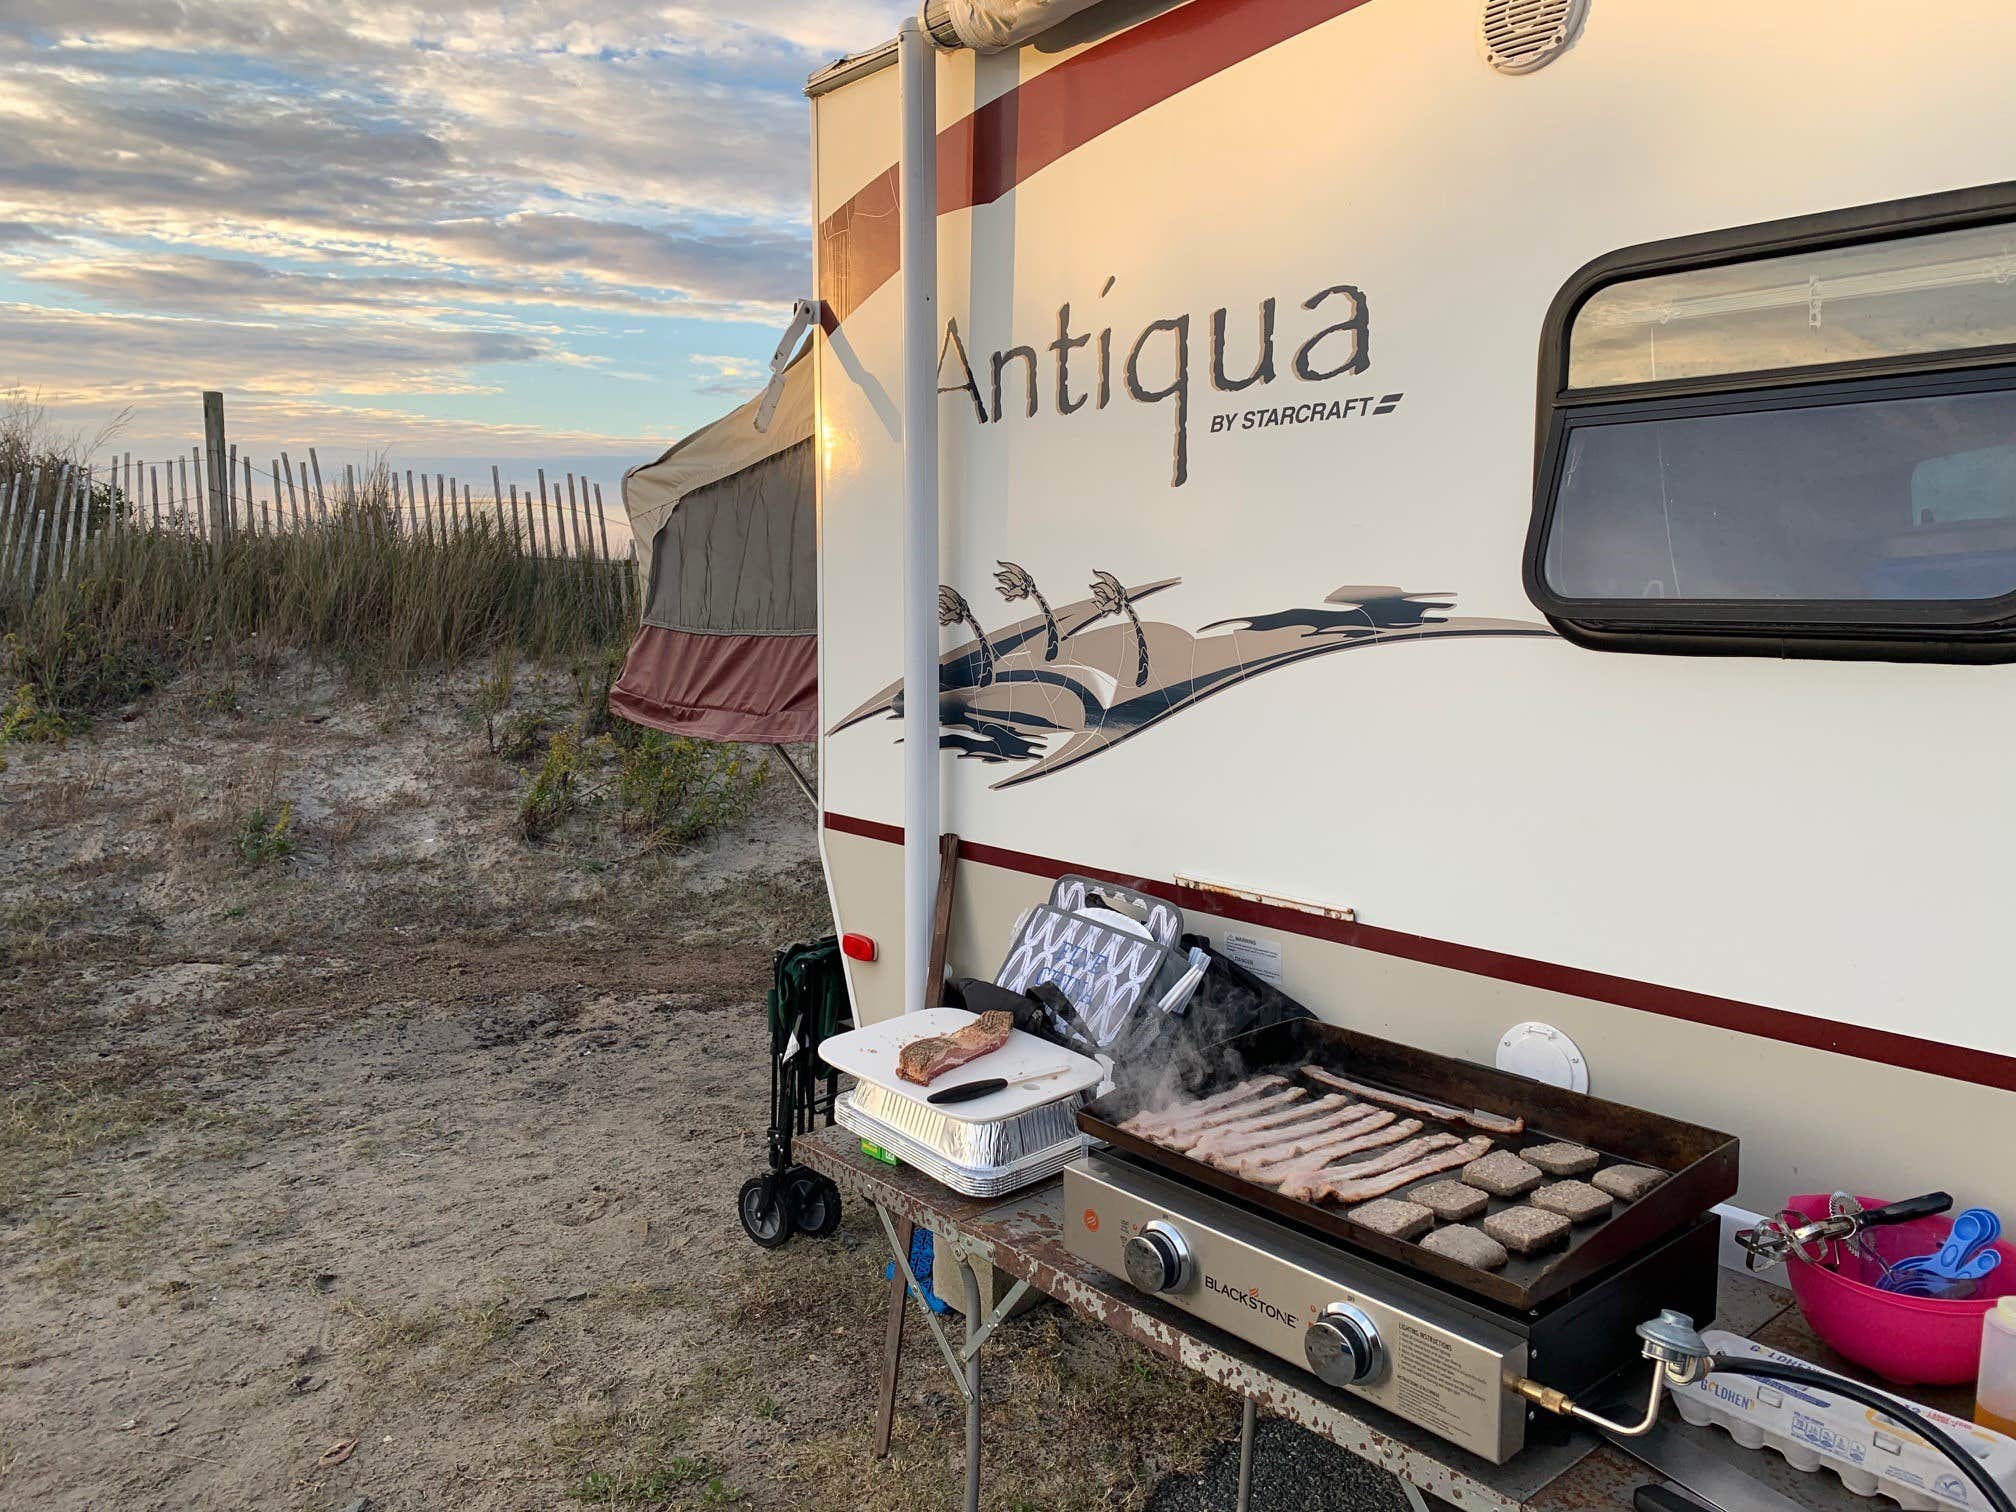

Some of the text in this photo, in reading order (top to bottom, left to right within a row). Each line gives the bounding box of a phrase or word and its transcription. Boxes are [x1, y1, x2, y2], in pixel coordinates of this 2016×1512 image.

[1210, 396, 1375, 433] BY STARCRAFT
[1234, 935, 1257, 946] WARNING
[1204, 1275, 1298, 1329] BLACKSTONE
[1700, 1378, 1750, 1410] GOLDHEN
